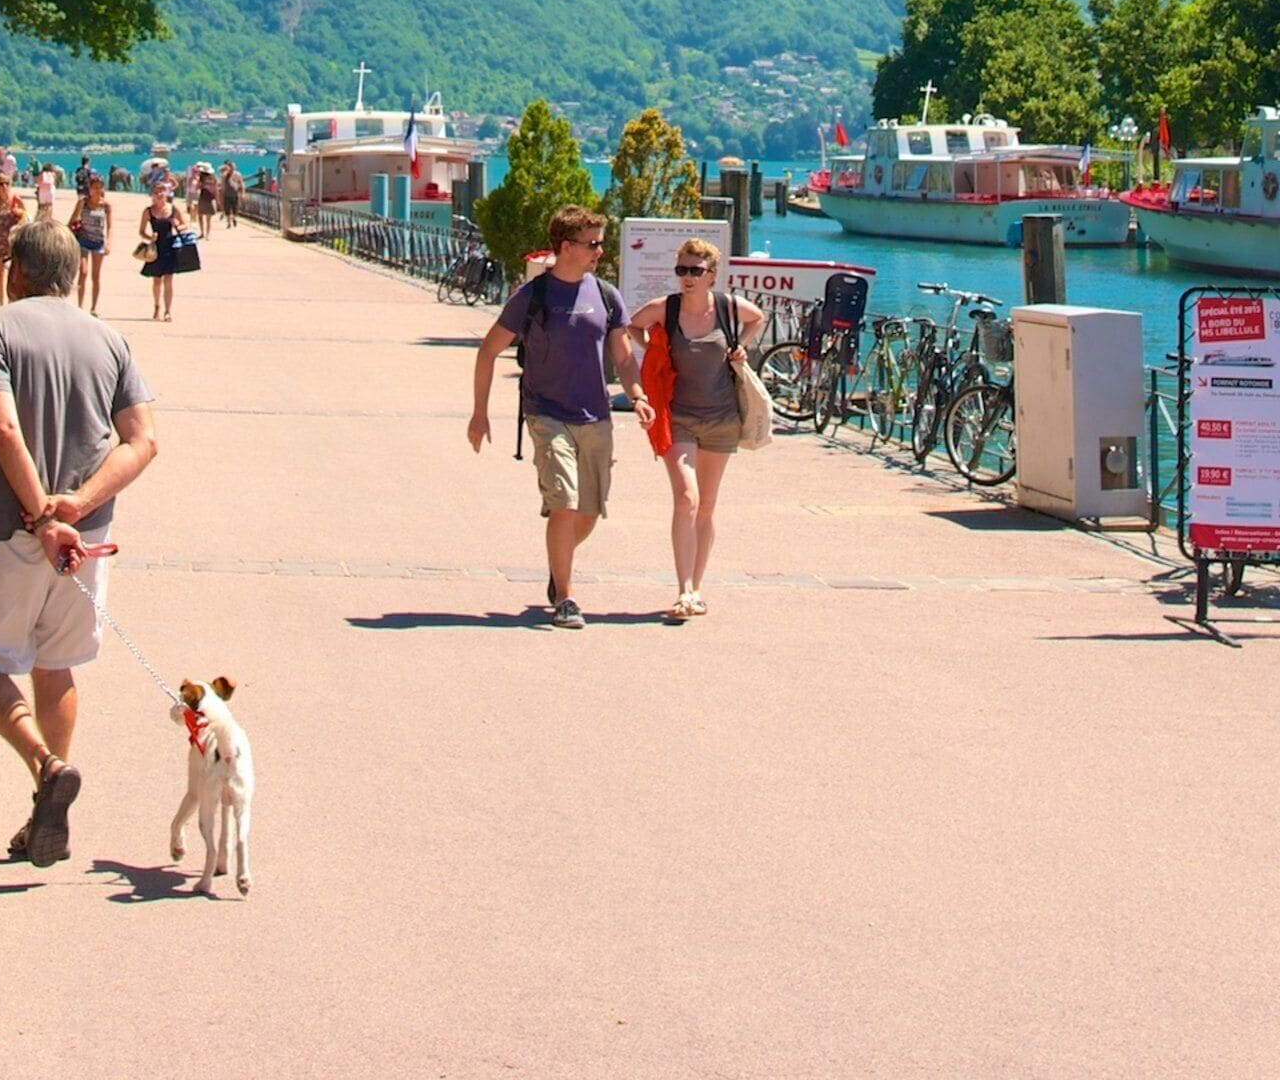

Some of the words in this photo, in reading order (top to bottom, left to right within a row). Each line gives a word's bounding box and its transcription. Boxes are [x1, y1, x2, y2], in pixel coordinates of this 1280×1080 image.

[1200, 307, 1229, 317] SPÉCIAL
[1208, 319, 1232, 329] BORD
[1233, 318, 1245, 327] DU
[1201, 328, 1214, 338] MS
[1215, 325, 1260, 336] LIBELLULE
